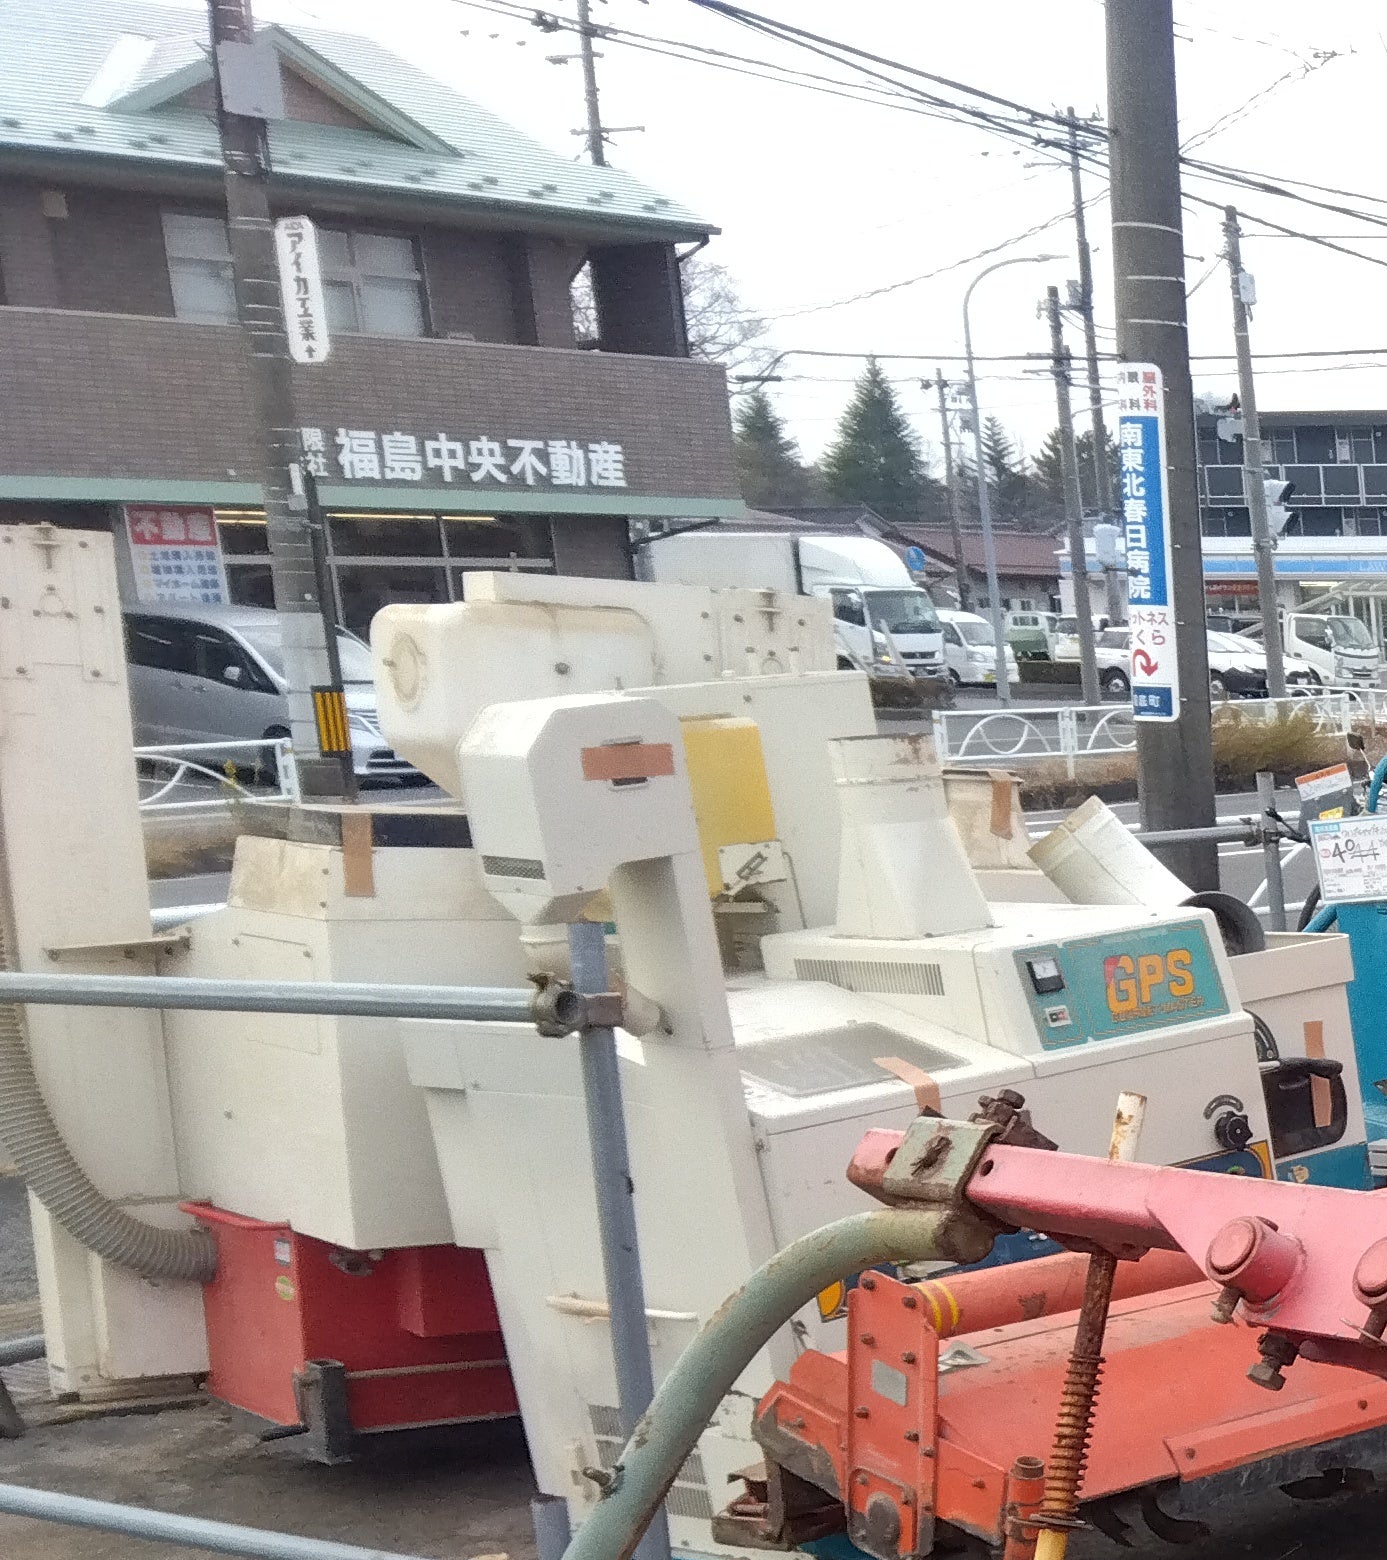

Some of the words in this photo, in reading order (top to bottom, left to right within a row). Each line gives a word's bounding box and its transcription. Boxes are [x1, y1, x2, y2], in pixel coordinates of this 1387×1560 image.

[334, 427, 627, 488] 福島中央不動産
[1120, 421, 1152, 600] 南東北春日病院
[1103, 948, 1195, 1015] GPS
